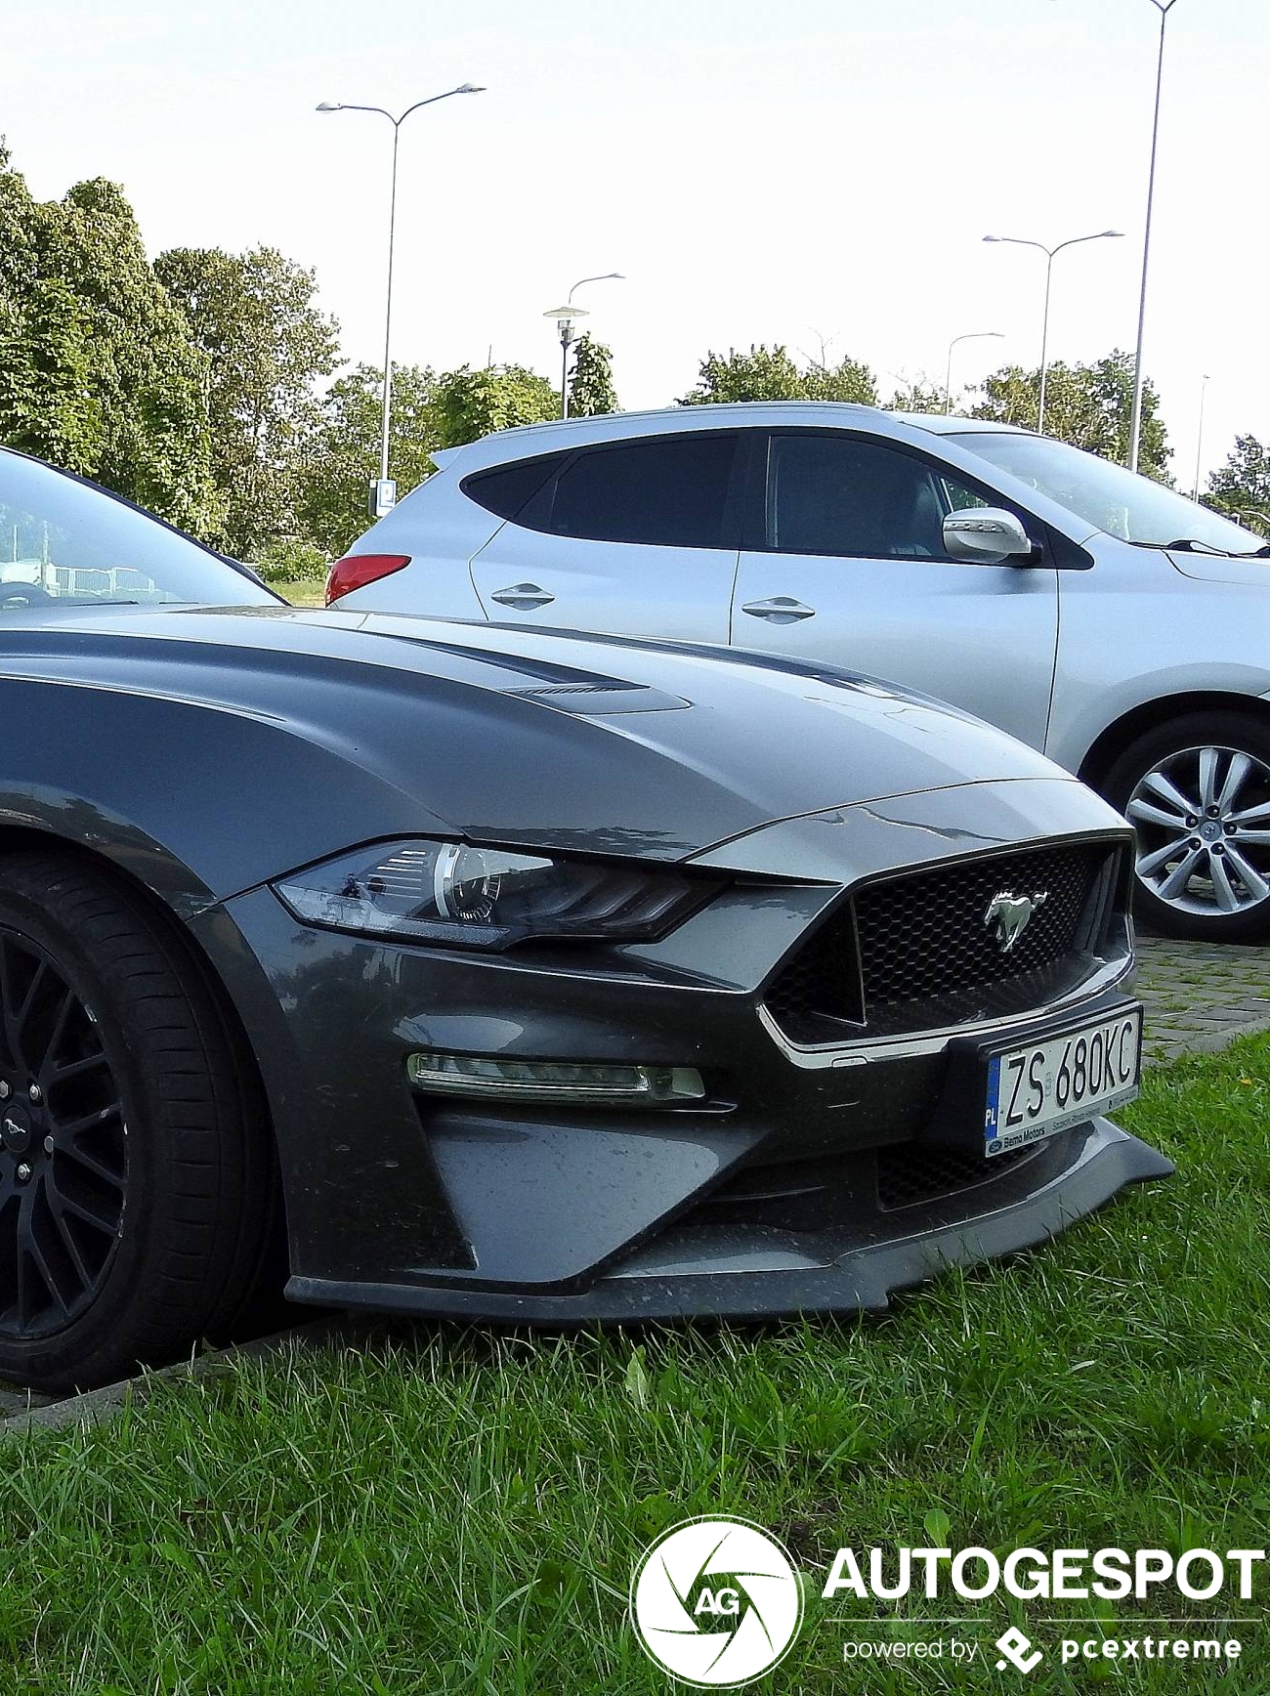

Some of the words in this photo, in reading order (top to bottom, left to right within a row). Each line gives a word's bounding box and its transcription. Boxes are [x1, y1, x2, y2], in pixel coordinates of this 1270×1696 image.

[1005, 1050, 1045, 1128] ZS
[1056, 1019, 1133, 1108] 680KC
[985, 1108, 997, 1128] PL
[1003, 1133, 1023, 1149] Bemo
[1023, 1126, 1046, 1142] Motors
